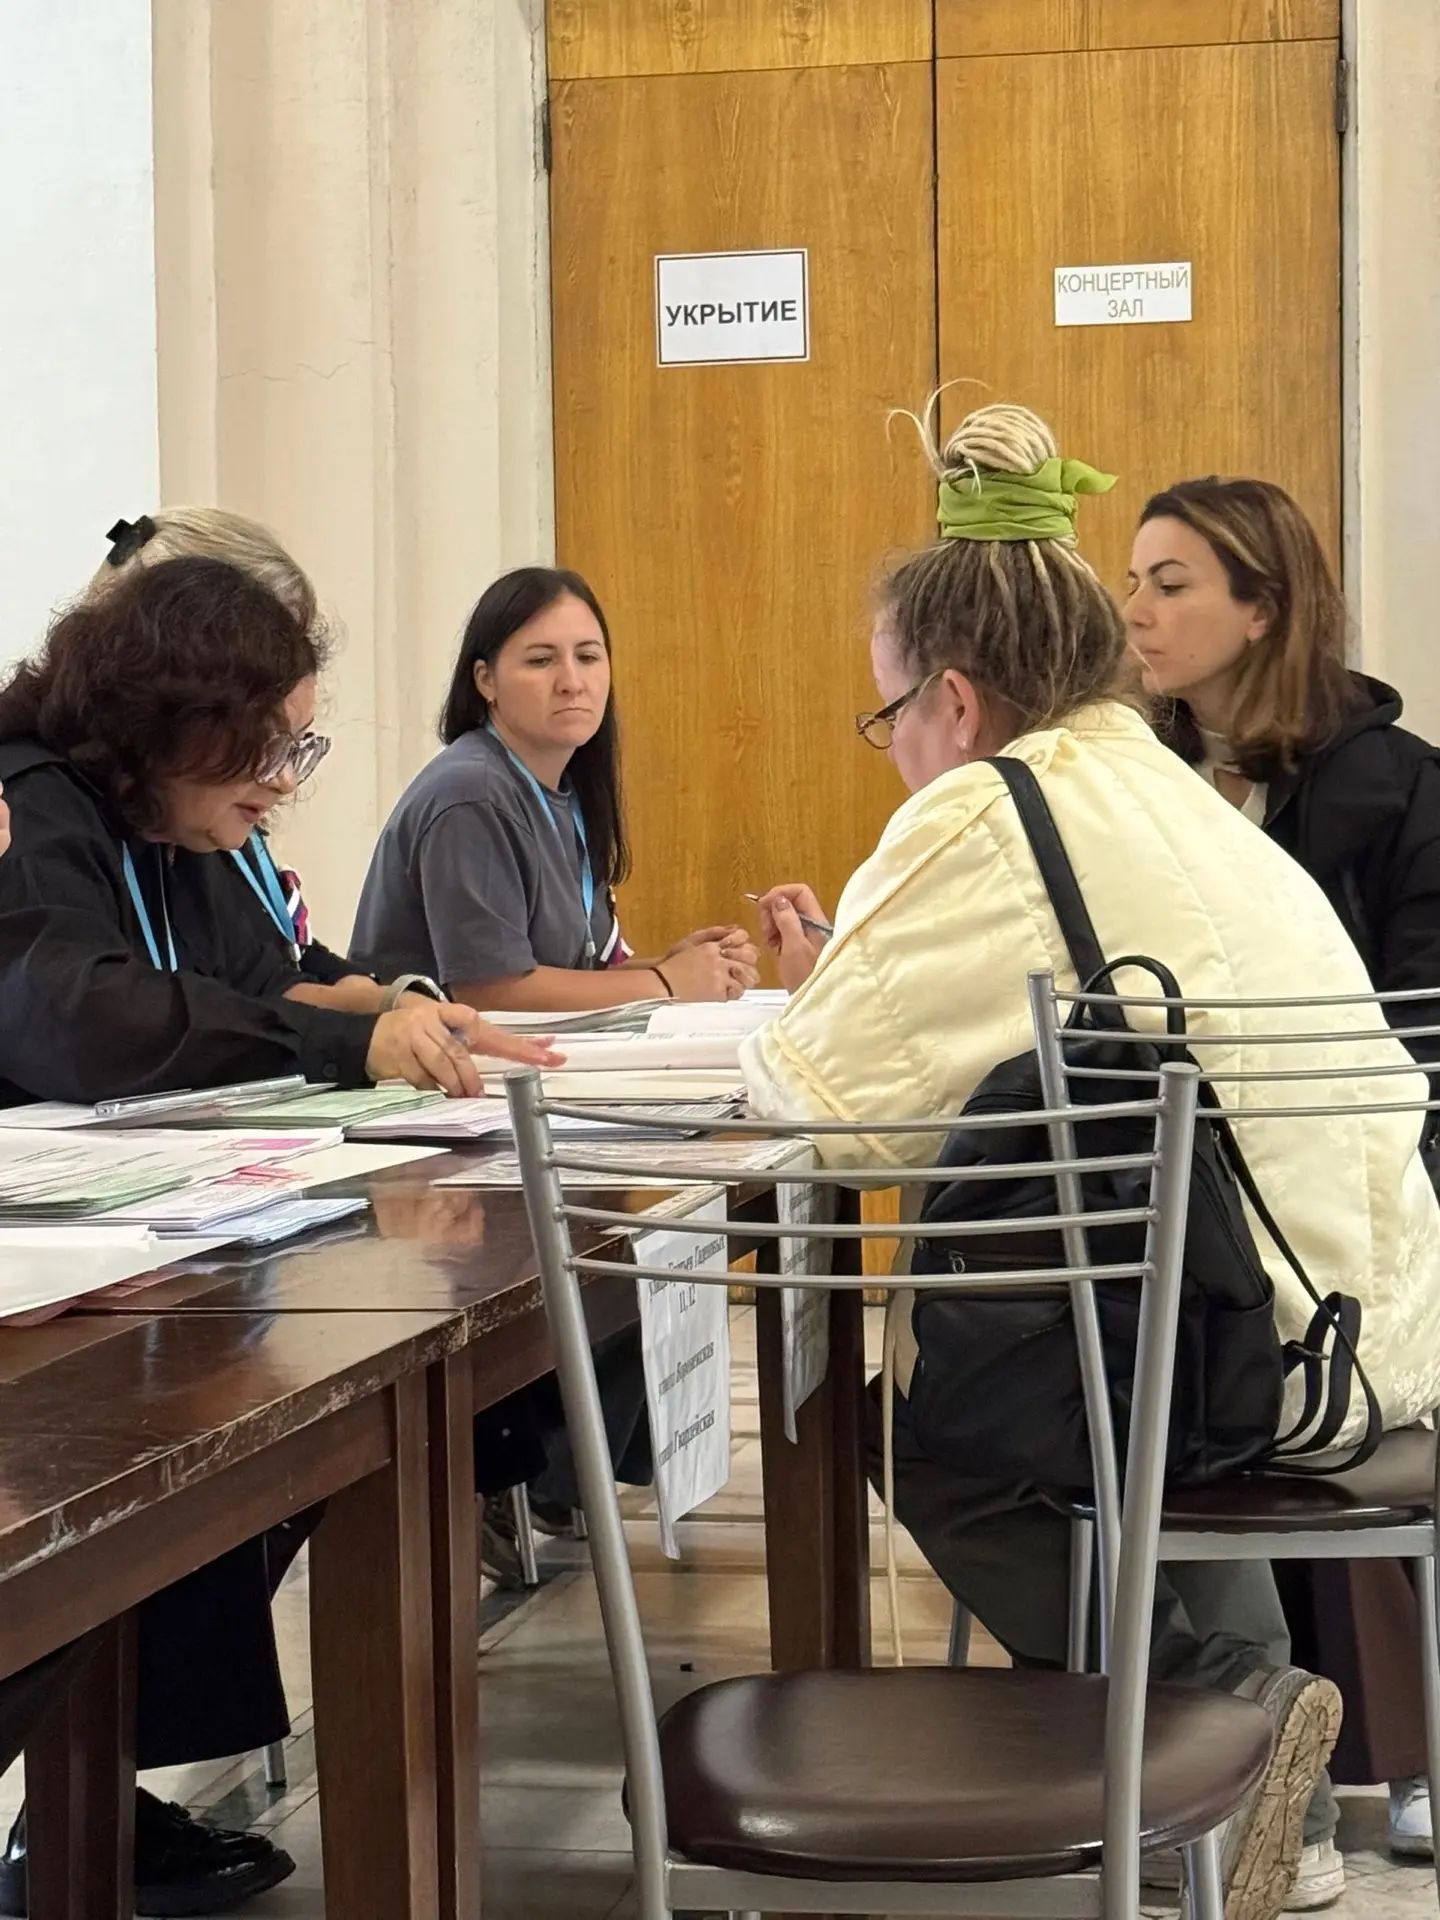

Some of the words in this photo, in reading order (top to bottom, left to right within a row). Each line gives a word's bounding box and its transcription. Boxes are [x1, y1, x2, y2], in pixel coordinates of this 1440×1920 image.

[1057, 266, 1189, 294] КОНЦЕРТНЫЙ
[666, 299, 797, 327] УКРЫТИЕ
[1108, 298, 1143, 319] ЗАЛ
